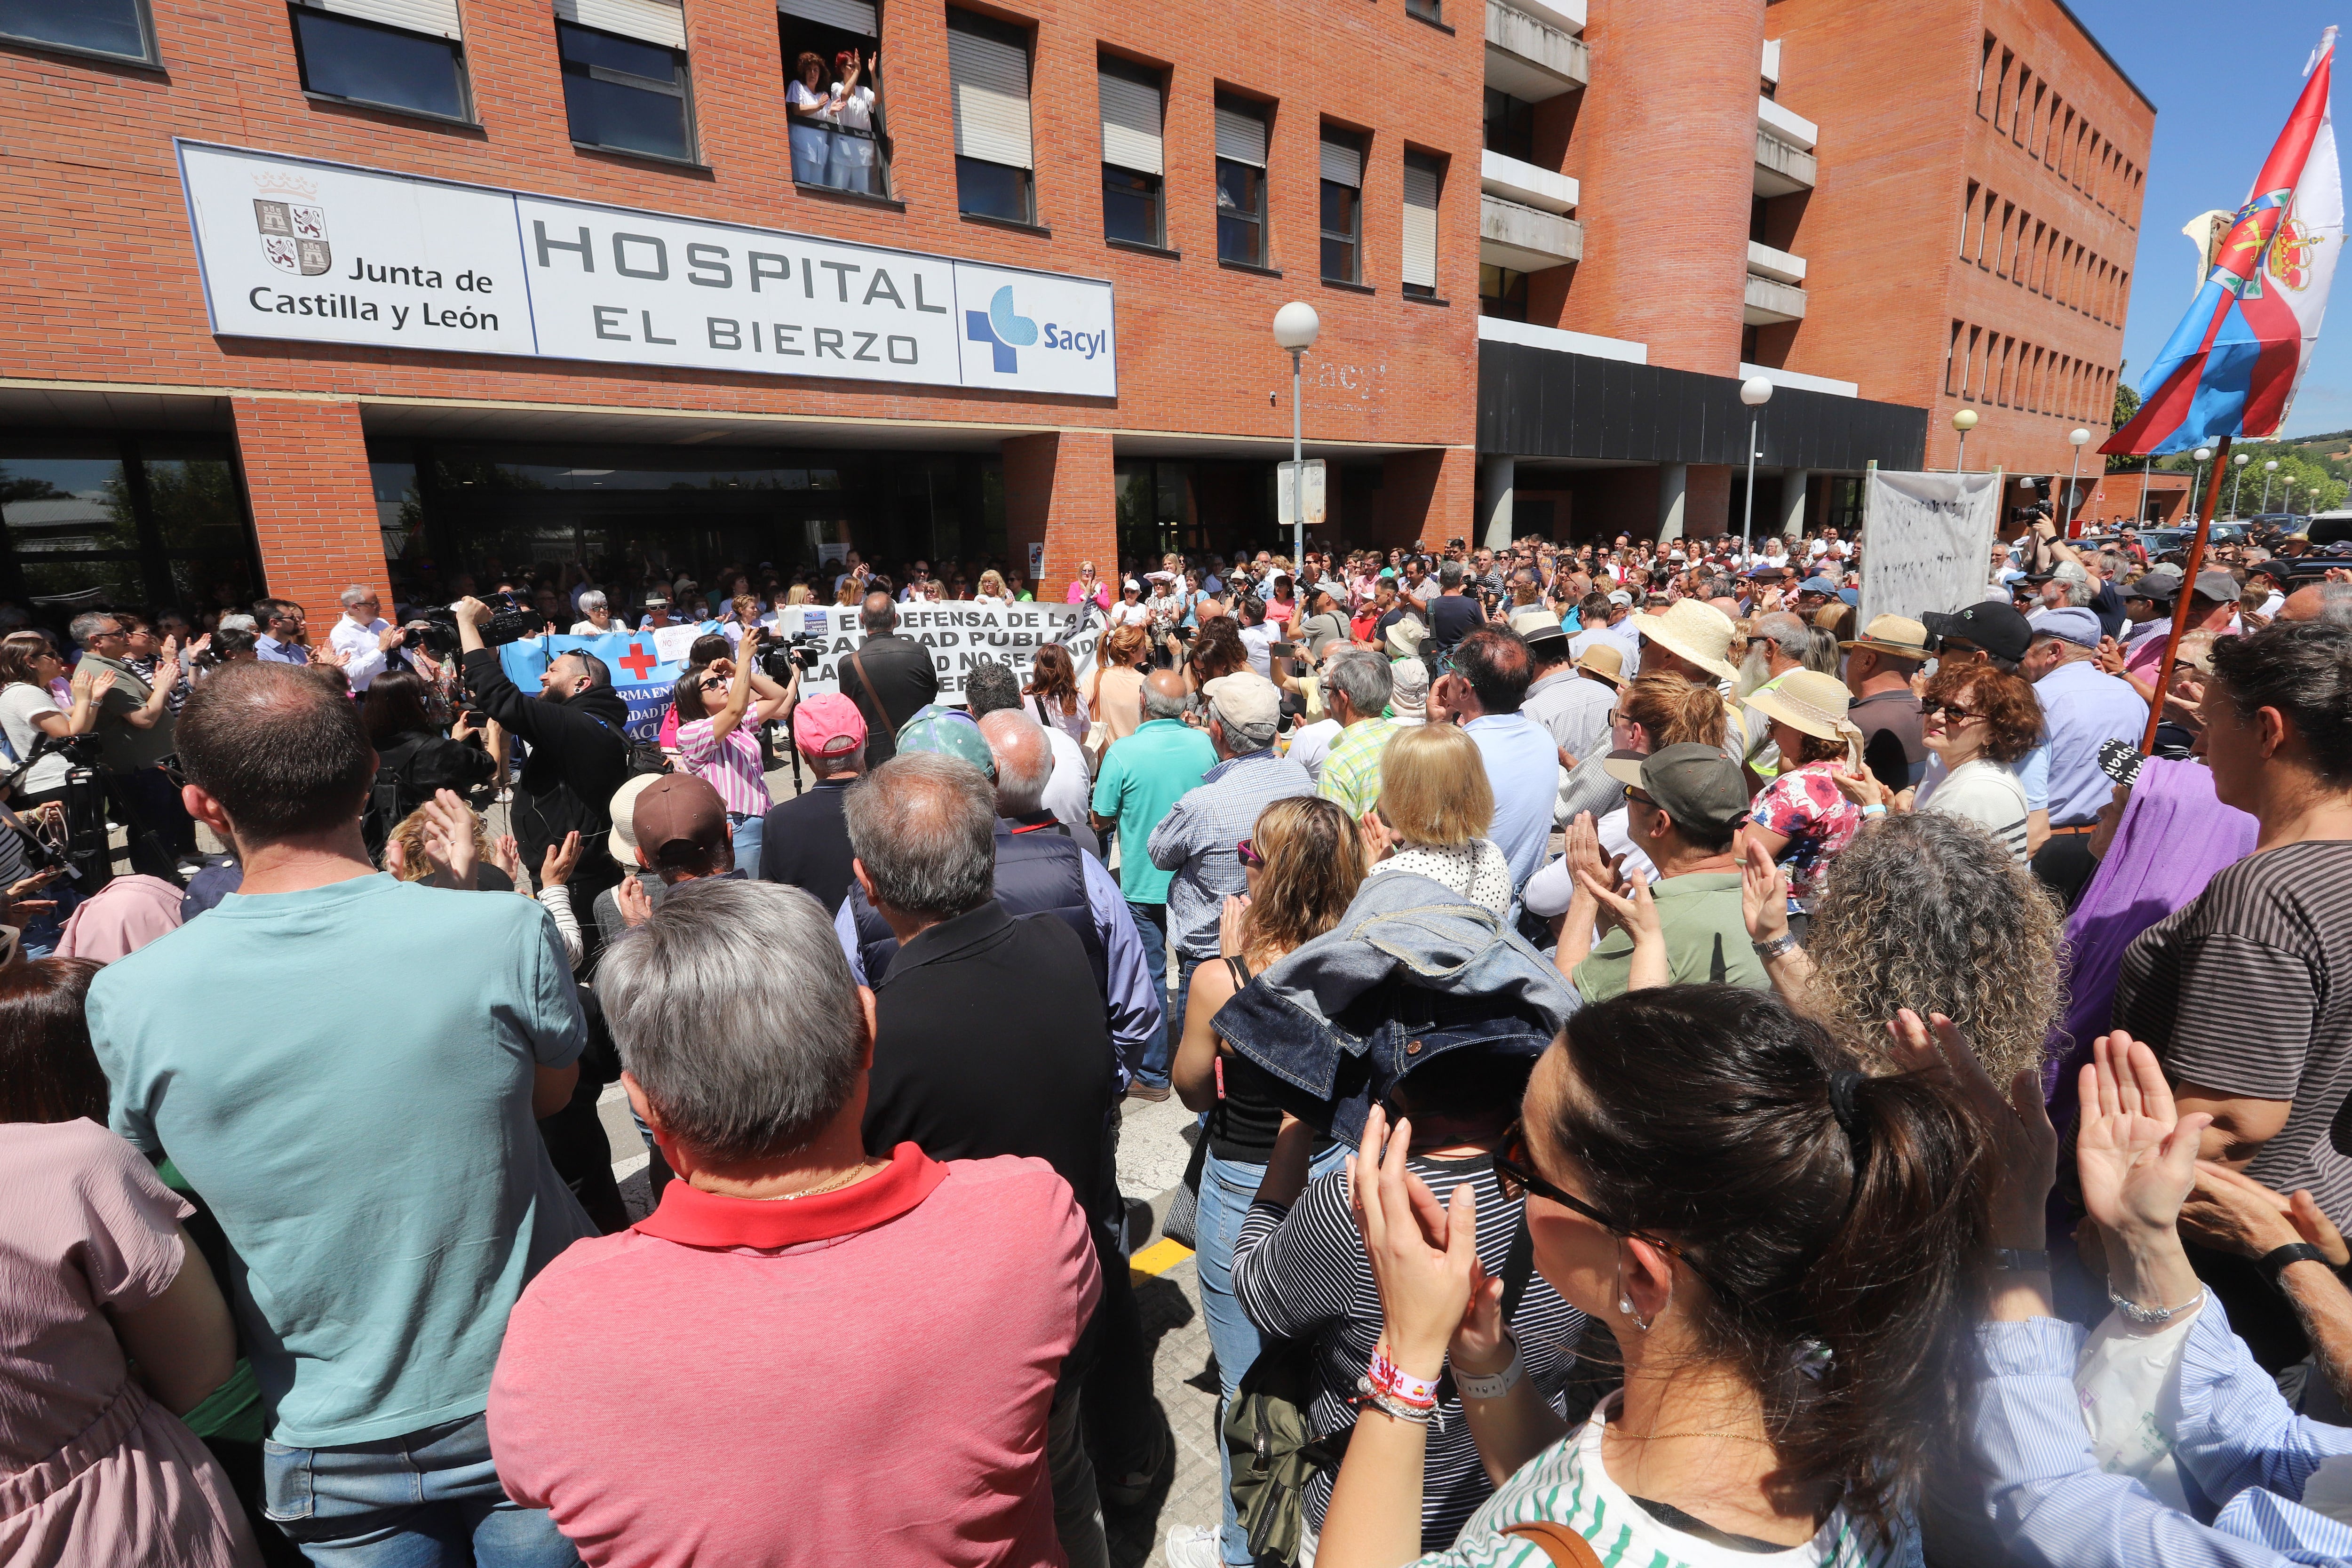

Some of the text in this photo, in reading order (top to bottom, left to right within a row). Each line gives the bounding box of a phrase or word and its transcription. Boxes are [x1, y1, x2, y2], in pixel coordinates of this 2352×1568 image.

[349, 257, 493, 294] Junta de
[533, 220, 946, 314] HOSPITAL
[250, 287, 499, 330] Castilla y León
[593, 305, 918, 365] EL BIERZO
[1044, 323, 1105, 359] Sacyl
[1007, 613, 1039, 627] DE
[1049, 613, 1077, 627] LA
[802, 663, 838, 683] LA
[999, 653, 1026, 668] SE
[616, 689, 652, 701] RMA
[626, 707, 659, 722] IDAD
